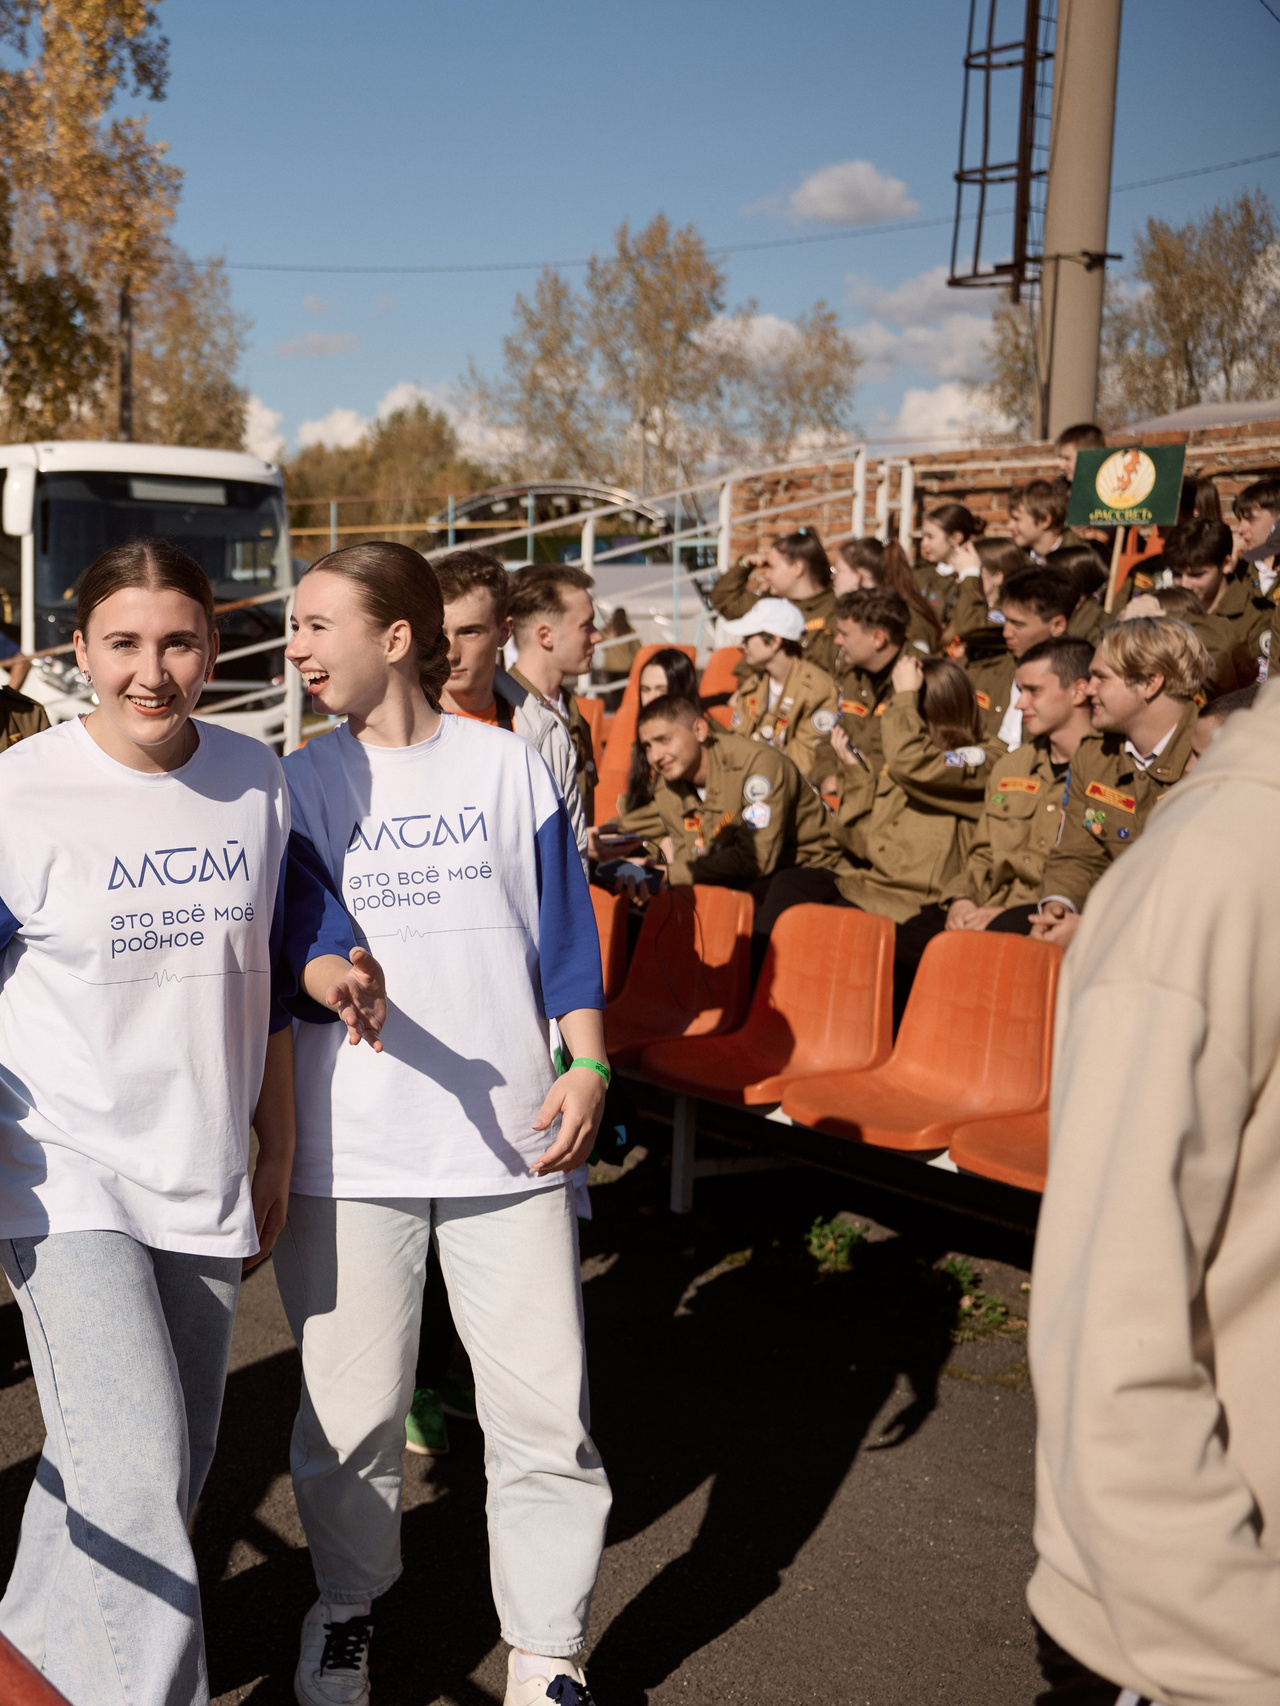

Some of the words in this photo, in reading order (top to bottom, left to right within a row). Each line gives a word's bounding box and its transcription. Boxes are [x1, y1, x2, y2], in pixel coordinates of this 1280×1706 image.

[345, 806, 489, 855] АЛТАЙ
[107, 840, 251, 891] АЛТАЙ
[348, 871, 391, 891] это
[398, 863, 440, 885] всё
[448, 860, 493, 882] моё
[109, 912, 154, 932] это
[162, 903, 206, 926] всё
[214, 902, 255, 923] моё
[352, 890, 442, 916] родное
[110, 929, 205, 960] родное
